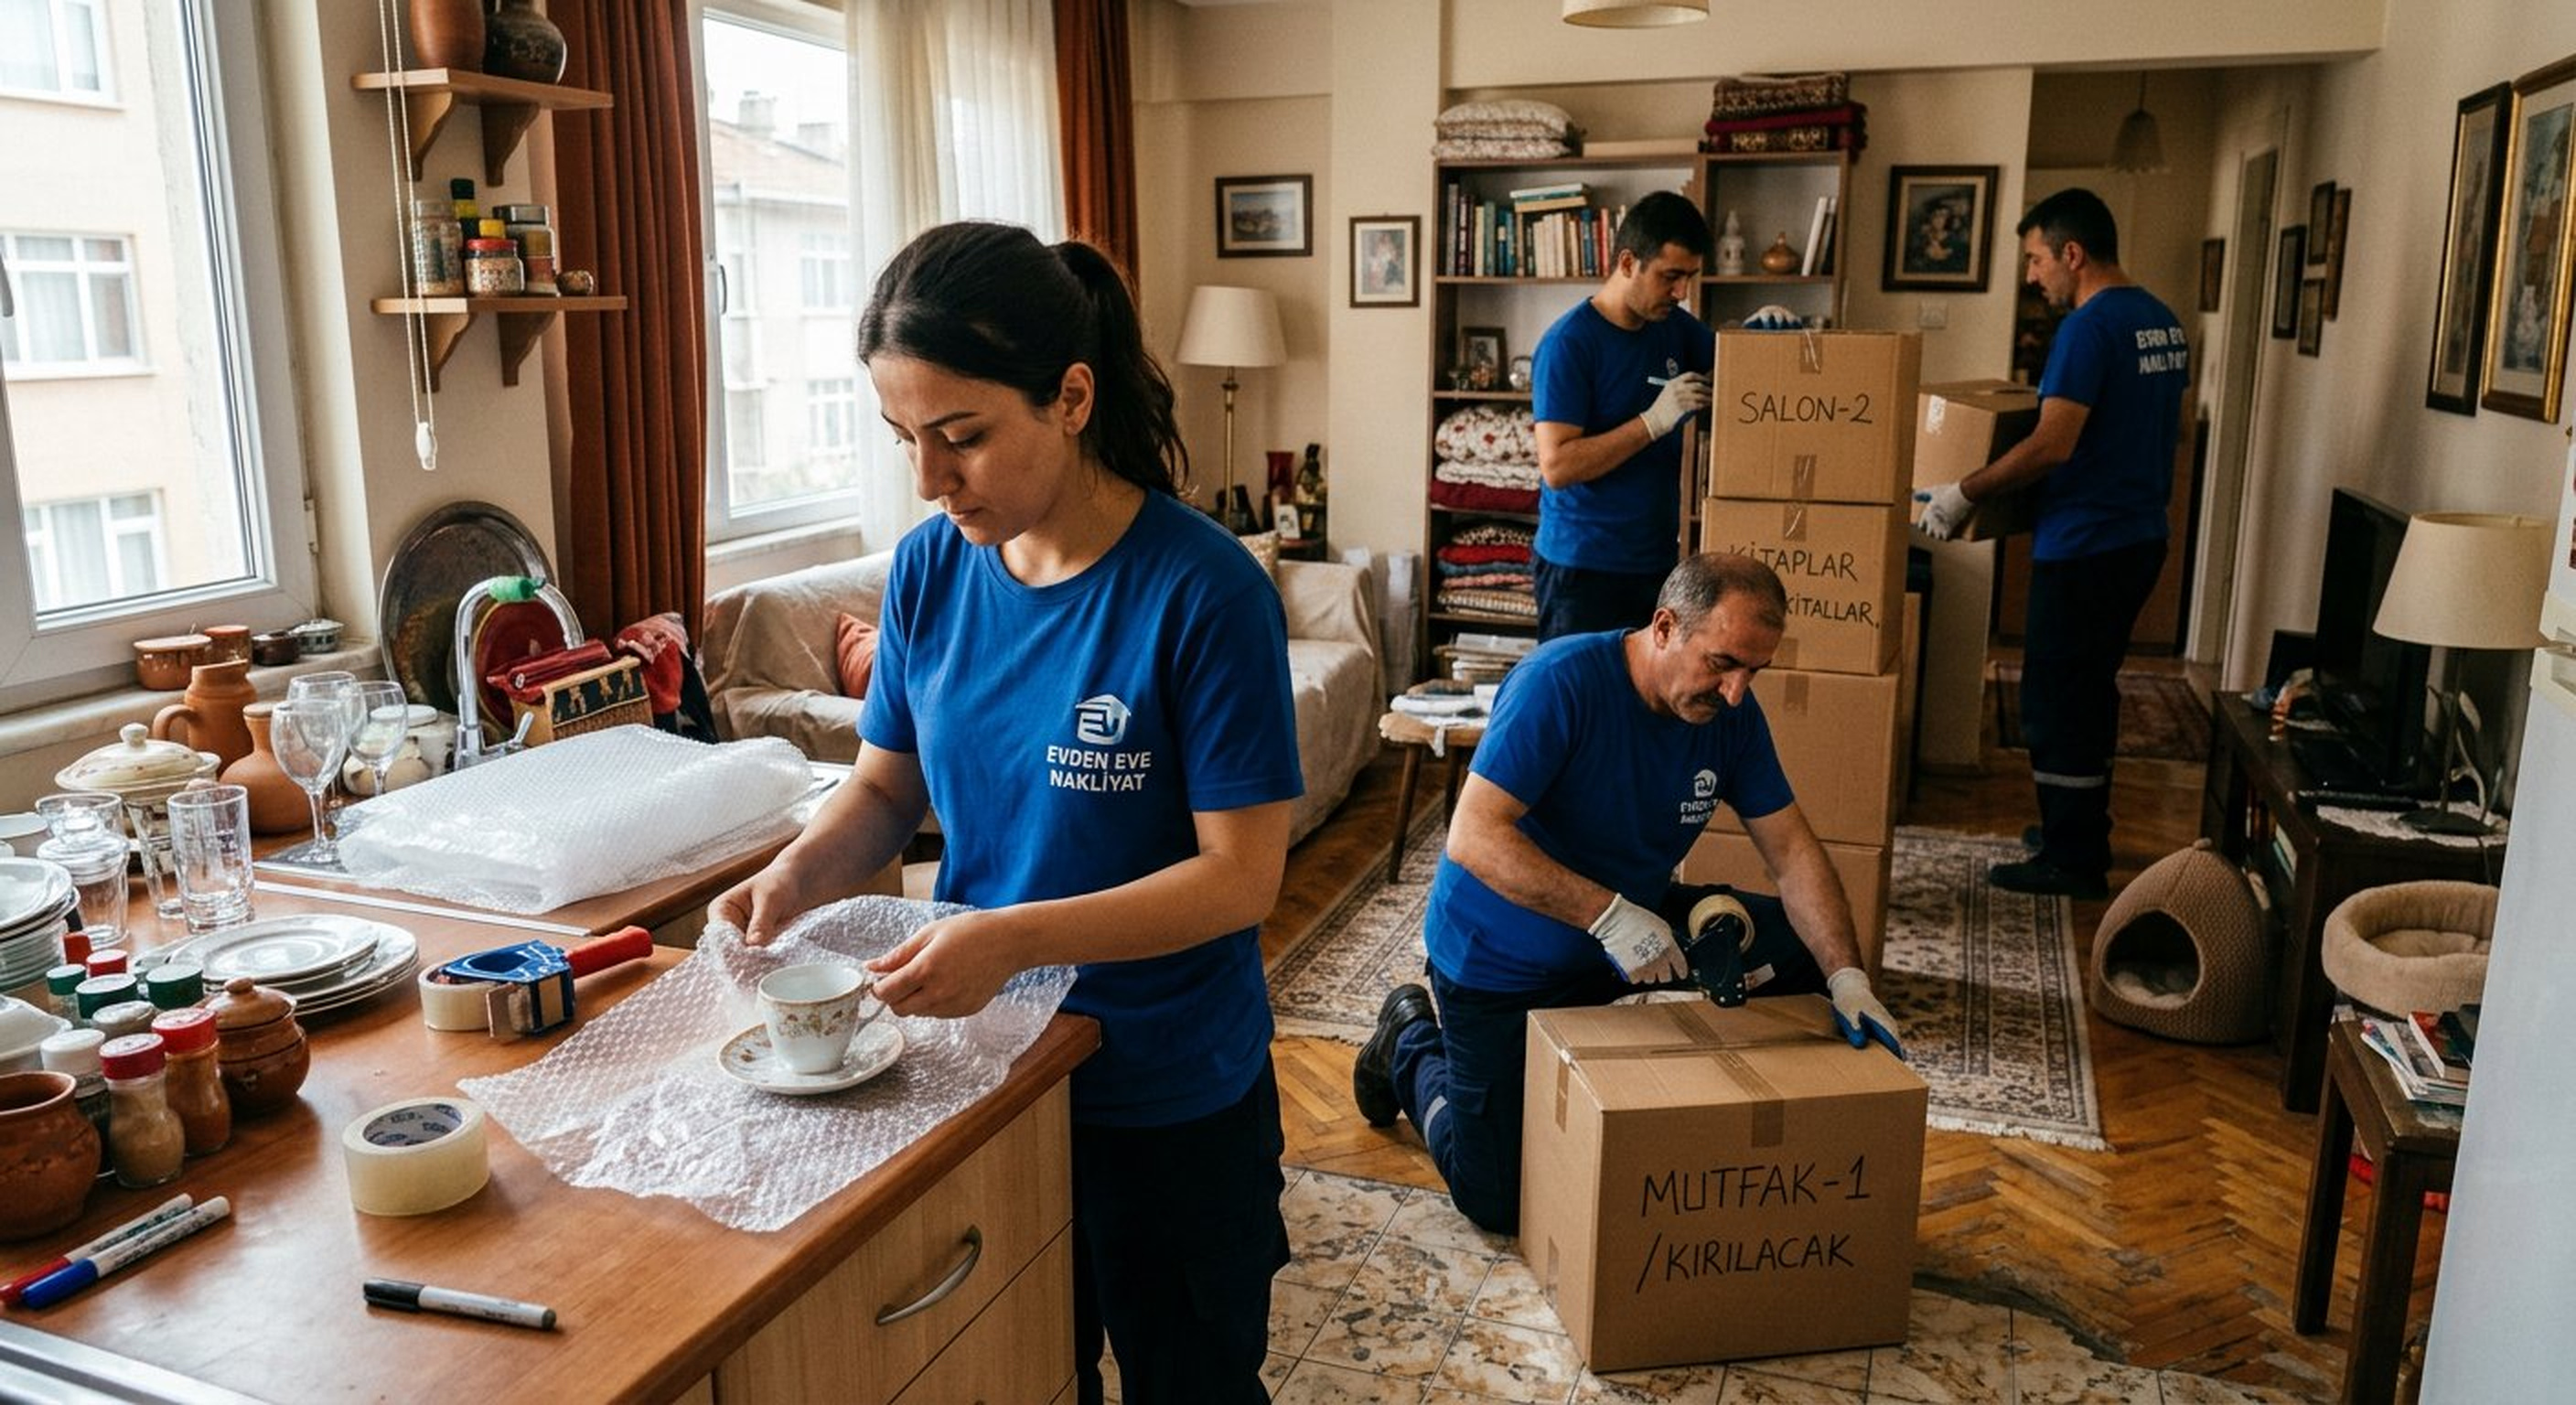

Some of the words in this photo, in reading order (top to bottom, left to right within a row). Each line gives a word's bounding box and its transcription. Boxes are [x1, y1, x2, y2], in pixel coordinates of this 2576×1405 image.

[1738, 391, 1873, 424] SALON-2
[1046, 745, 1110, 770] EVDEN
[1113, 751, 1153, 770] EVE
[1049, 769, 1146, 792] NAKLİYAT
[1641, 1154, 1872, 1217] MUTFAK-1
